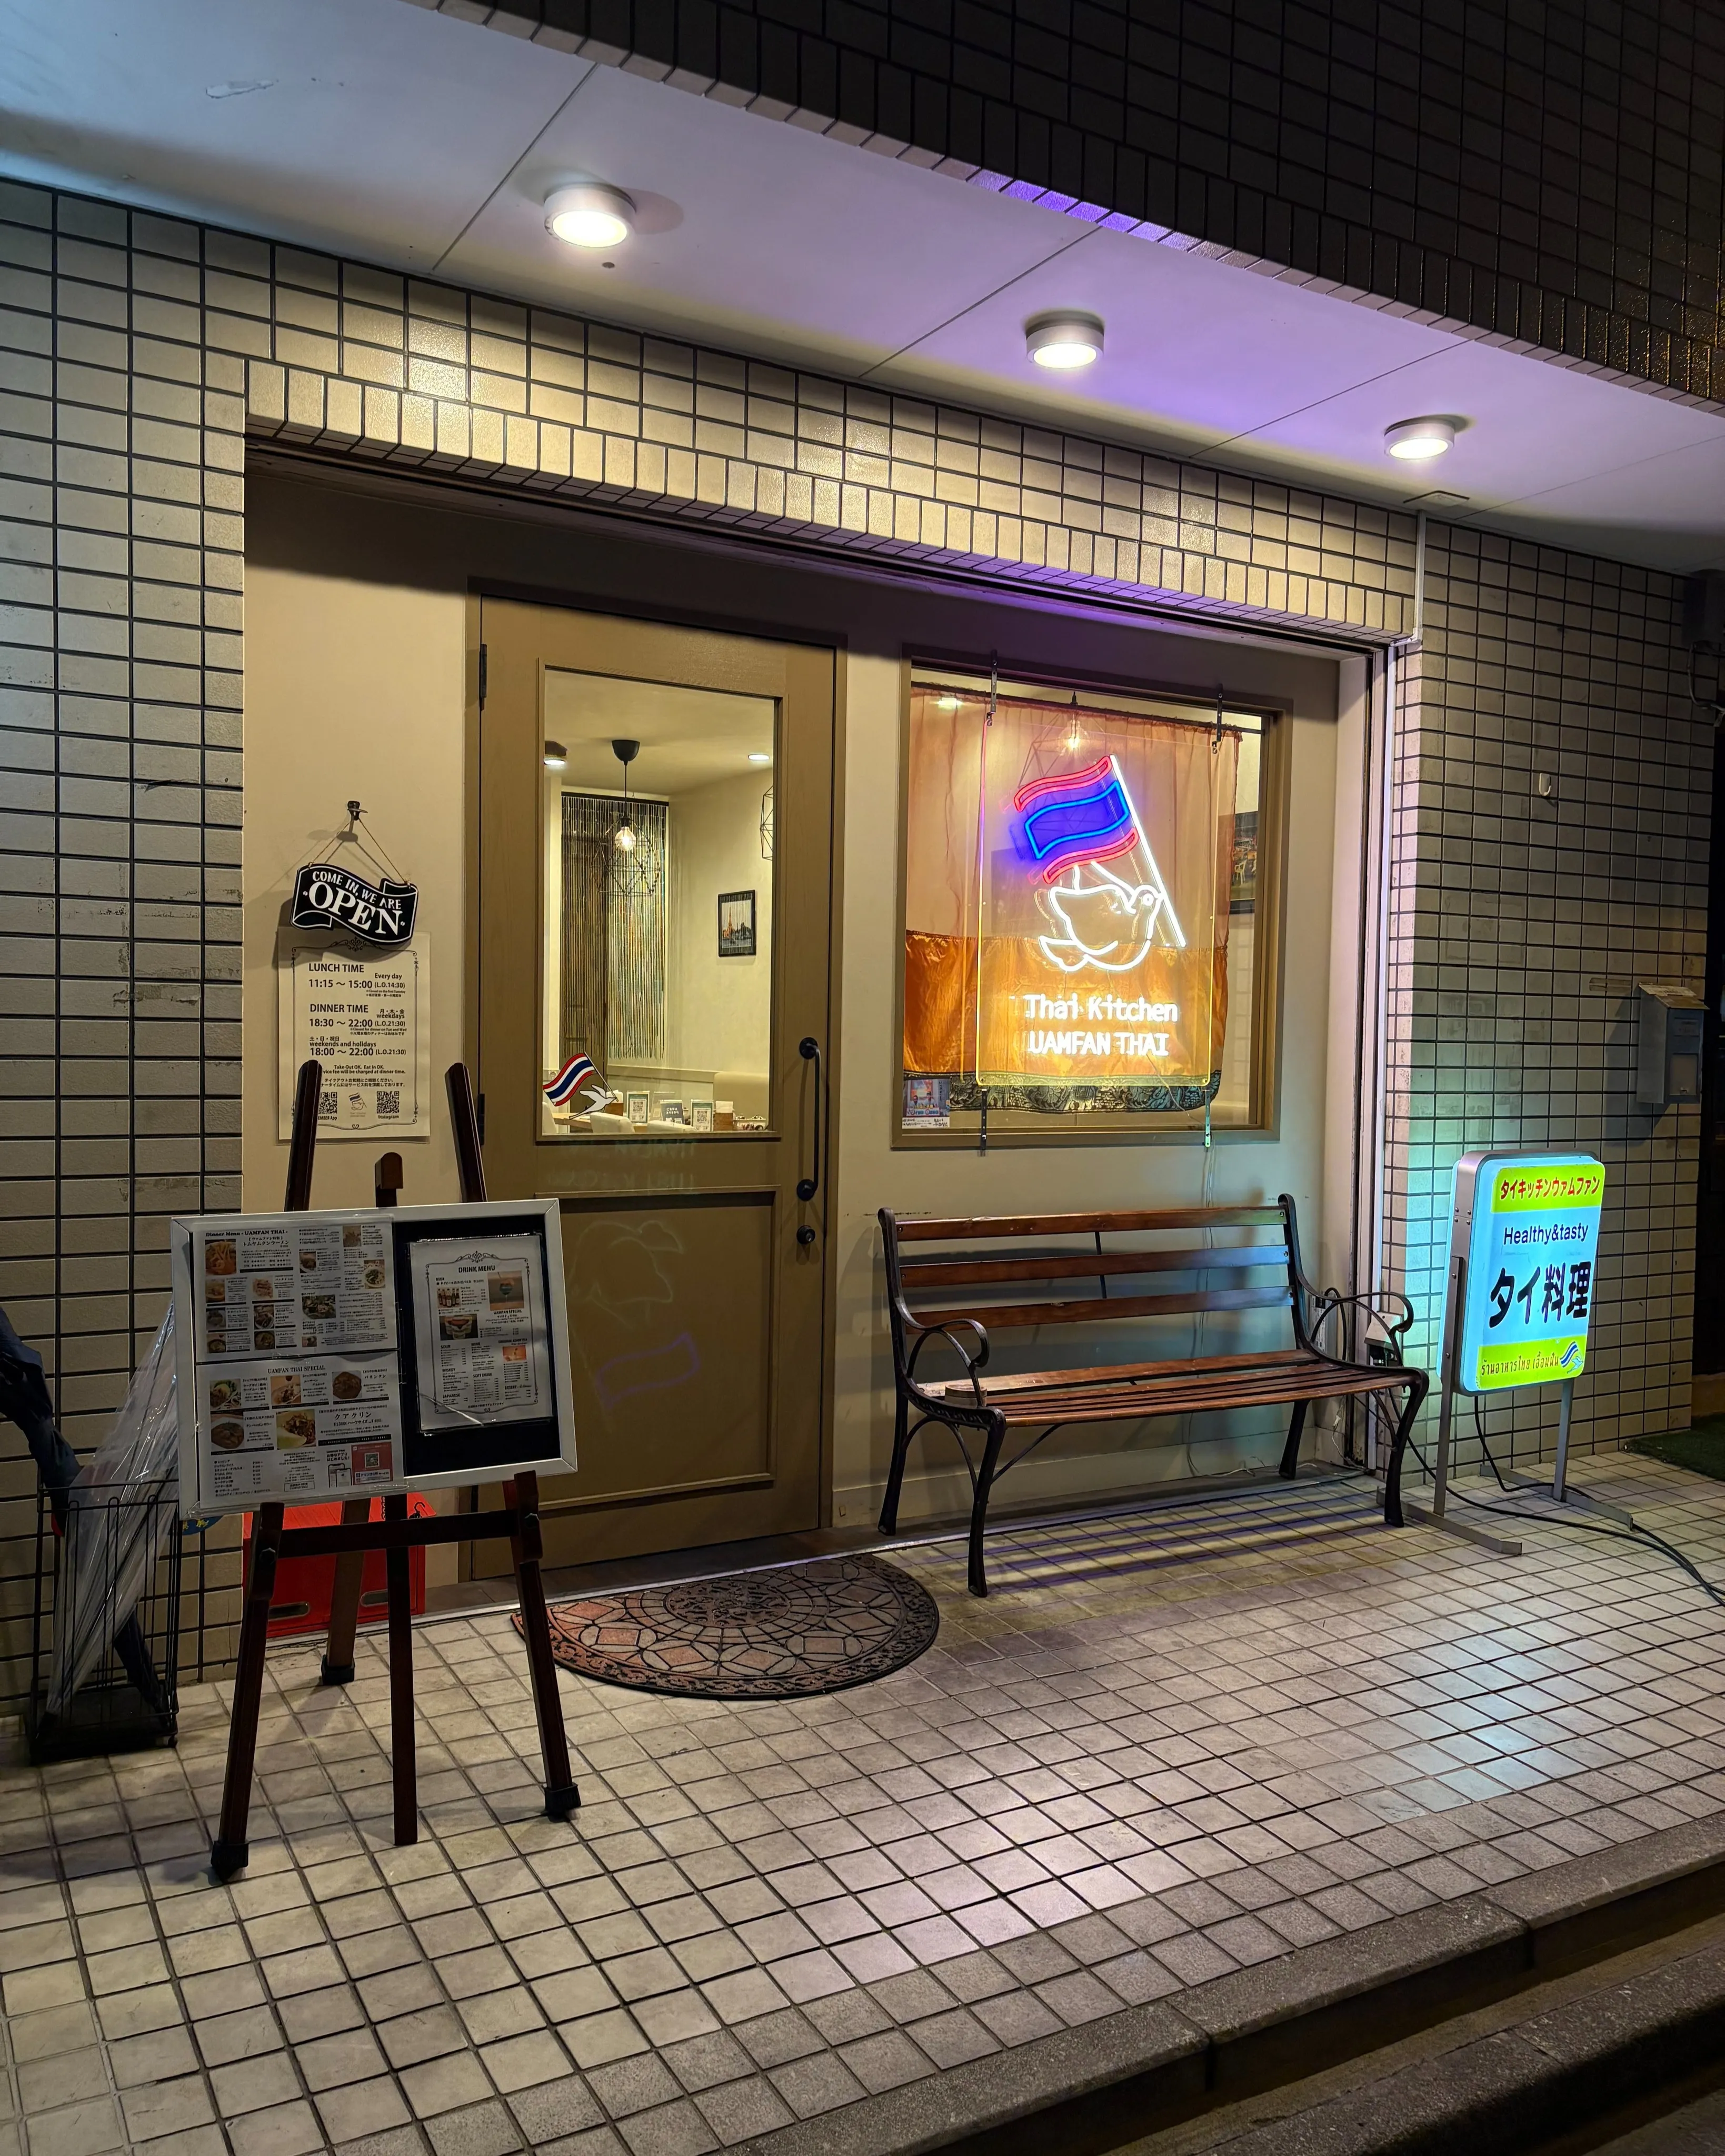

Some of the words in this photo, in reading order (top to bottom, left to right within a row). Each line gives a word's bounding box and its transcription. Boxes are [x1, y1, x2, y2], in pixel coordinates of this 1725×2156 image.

[313, 871, 343, 885] COME
[345, 879, 358, 896] IN,
[362, 889, 377, 904] WE
[380, 897, 401, 909] ARE
[309, 882, 403, 935] OPEN
[309, 963, 340, 972] LUNCH
[342, 964, 364, 973] TIME
[309, 979, 333, 987] 11:15
[348, 980, 372, 989] 15:00
[310, 1004, 344, 1012] DINNER
[346, 1004, 368, 1013] TIME
[1023, 993, 1078, 1020] Thai
[1088, 994, 1178, 1022] Kitchen
[310, 1019, 334, 1027] 18:30
[310, 1047, 334, 1056] 18:00
[1028, 1030, 1111, 1056] UAMFAN
[1113, 1032, 1170, 1056] THAI
[1501, 1176, 1600, 1200] タイキッチンウァムファン
[1504, 1222, 1588, 1245] Healthy&tasty
[1489, 1261, 1591, 1328] タイ料理
[1481, 1355, 1530, 1375] ร้านอาหารไทย
